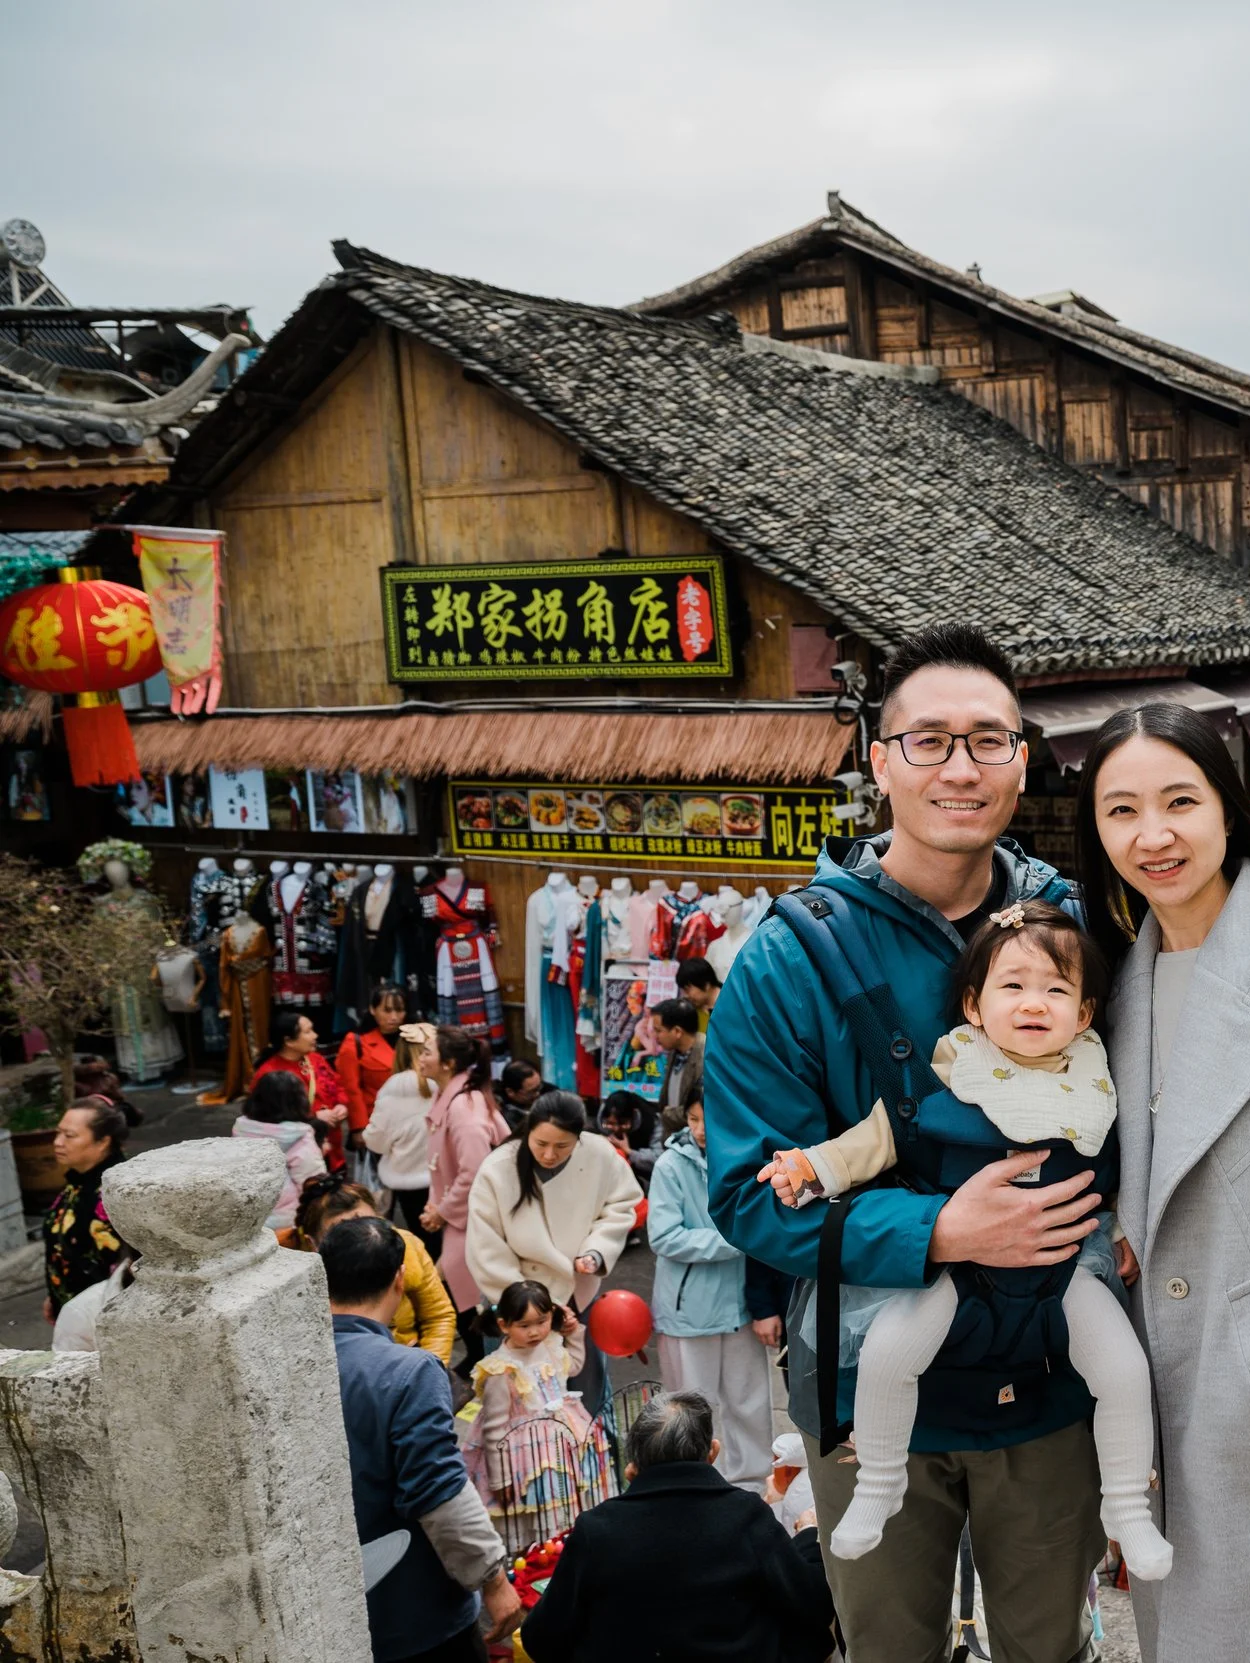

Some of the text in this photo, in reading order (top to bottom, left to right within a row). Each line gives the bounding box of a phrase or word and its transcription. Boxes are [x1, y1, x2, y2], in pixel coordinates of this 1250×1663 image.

[425, 577, 671, 649] 郑家拐角店
[681, 582, 705, 655] 老字号
